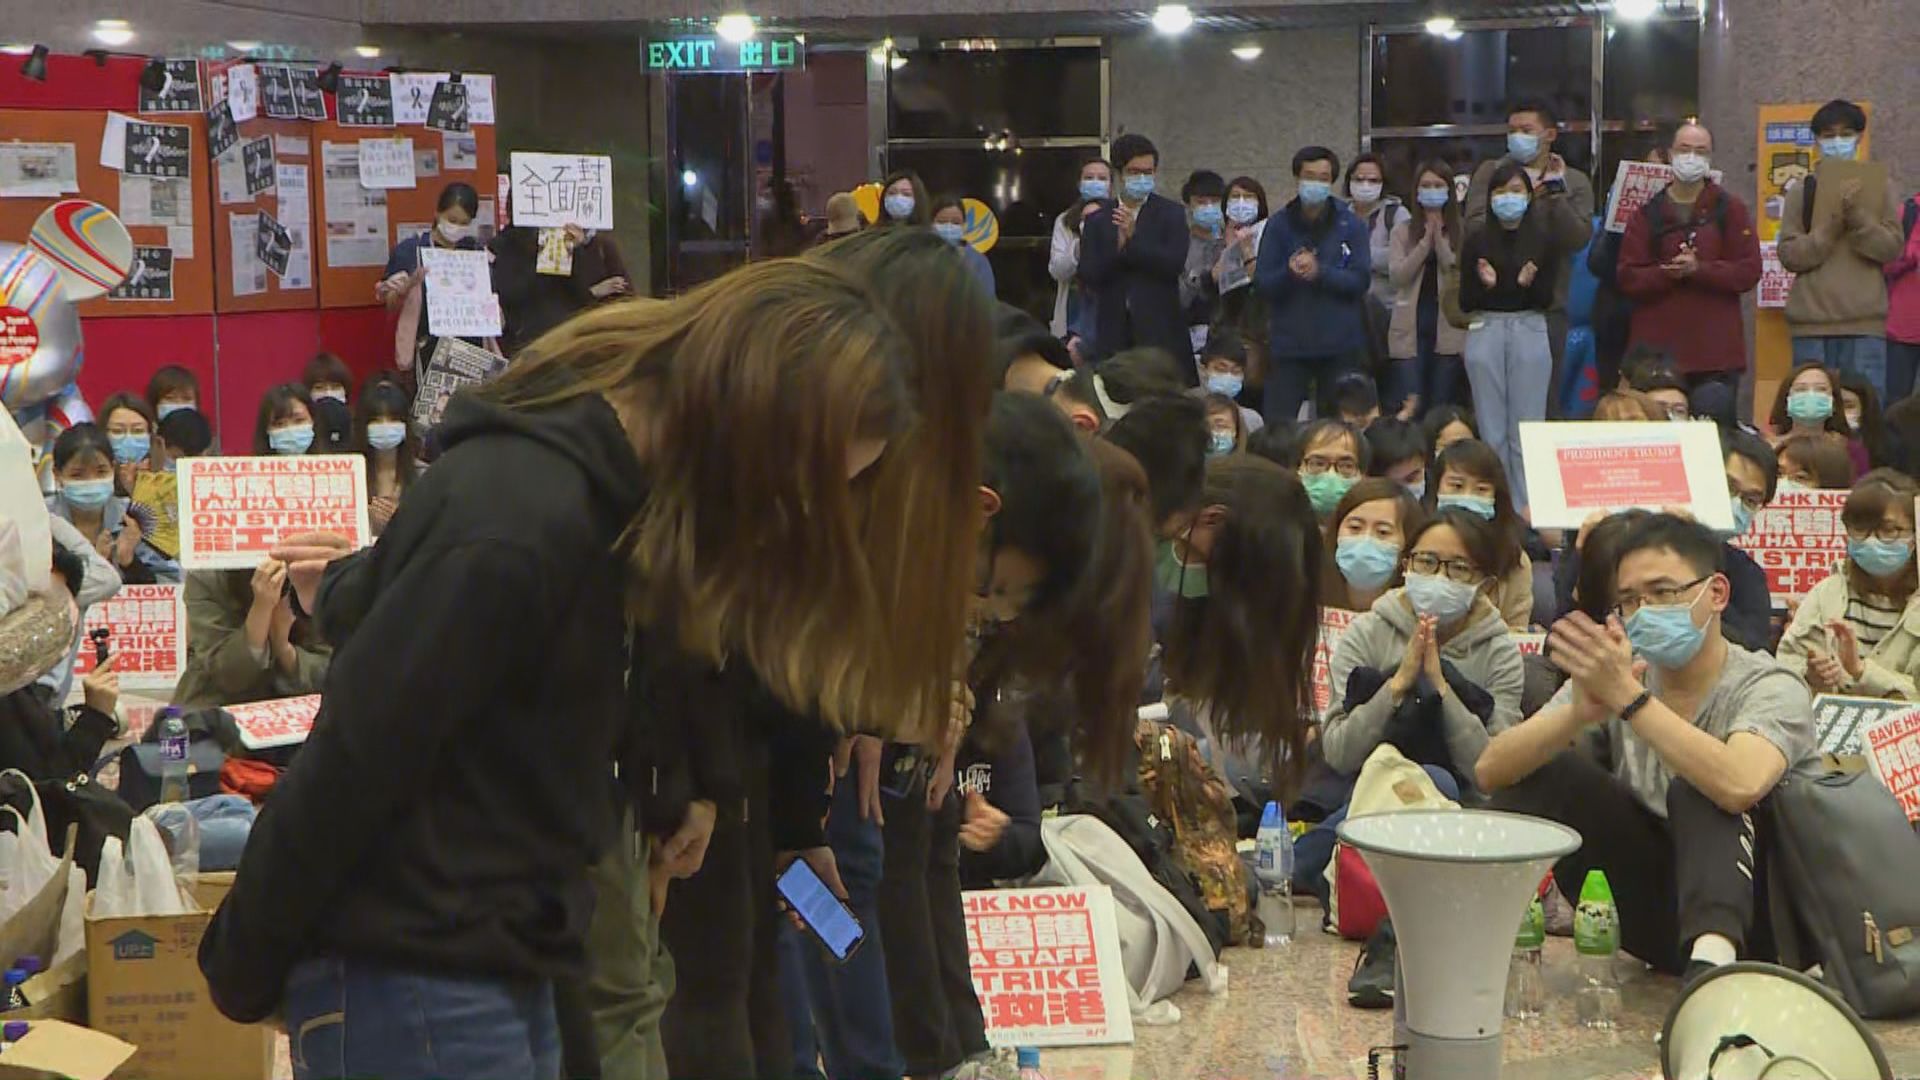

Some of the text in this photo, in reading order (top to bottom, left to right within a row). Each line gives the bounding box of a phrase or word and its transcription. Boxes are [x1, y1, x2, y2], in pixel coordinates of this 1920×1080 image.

[648, 40, 715, 68] EXIT
[739, 41, 795, 66] 出口
[1563, 447, 1675, 461] PRESIDENT TRUMP
[191, 459, 354, 473] SAVE HK NOW
[195, 497, 353, 510] I AM HA STAFF
[1779, 493, 1848, 505] HK NO
[193, 511, 358, 527] ON STRIKE
[193, 527, 358, 552] 罷工
[1765, 536, 1796, 547] HA
[1801, 536, 1847, 548] STA
[1763, 551, 1847, 566] STRI
[128, 586, 176, 597] NOW
[115, 623, 174, 634] STAFF
[82, 636, 177, 651] STRIKE
[1868, 720, 1903, 744] SAVE
[1008, 892, 1087, 910] NOW
[970, 949, 1091, 967] A STAFF
[973, 969, 1101, 992] TRIKE
[980, 991, 1106, 1029] 救港
